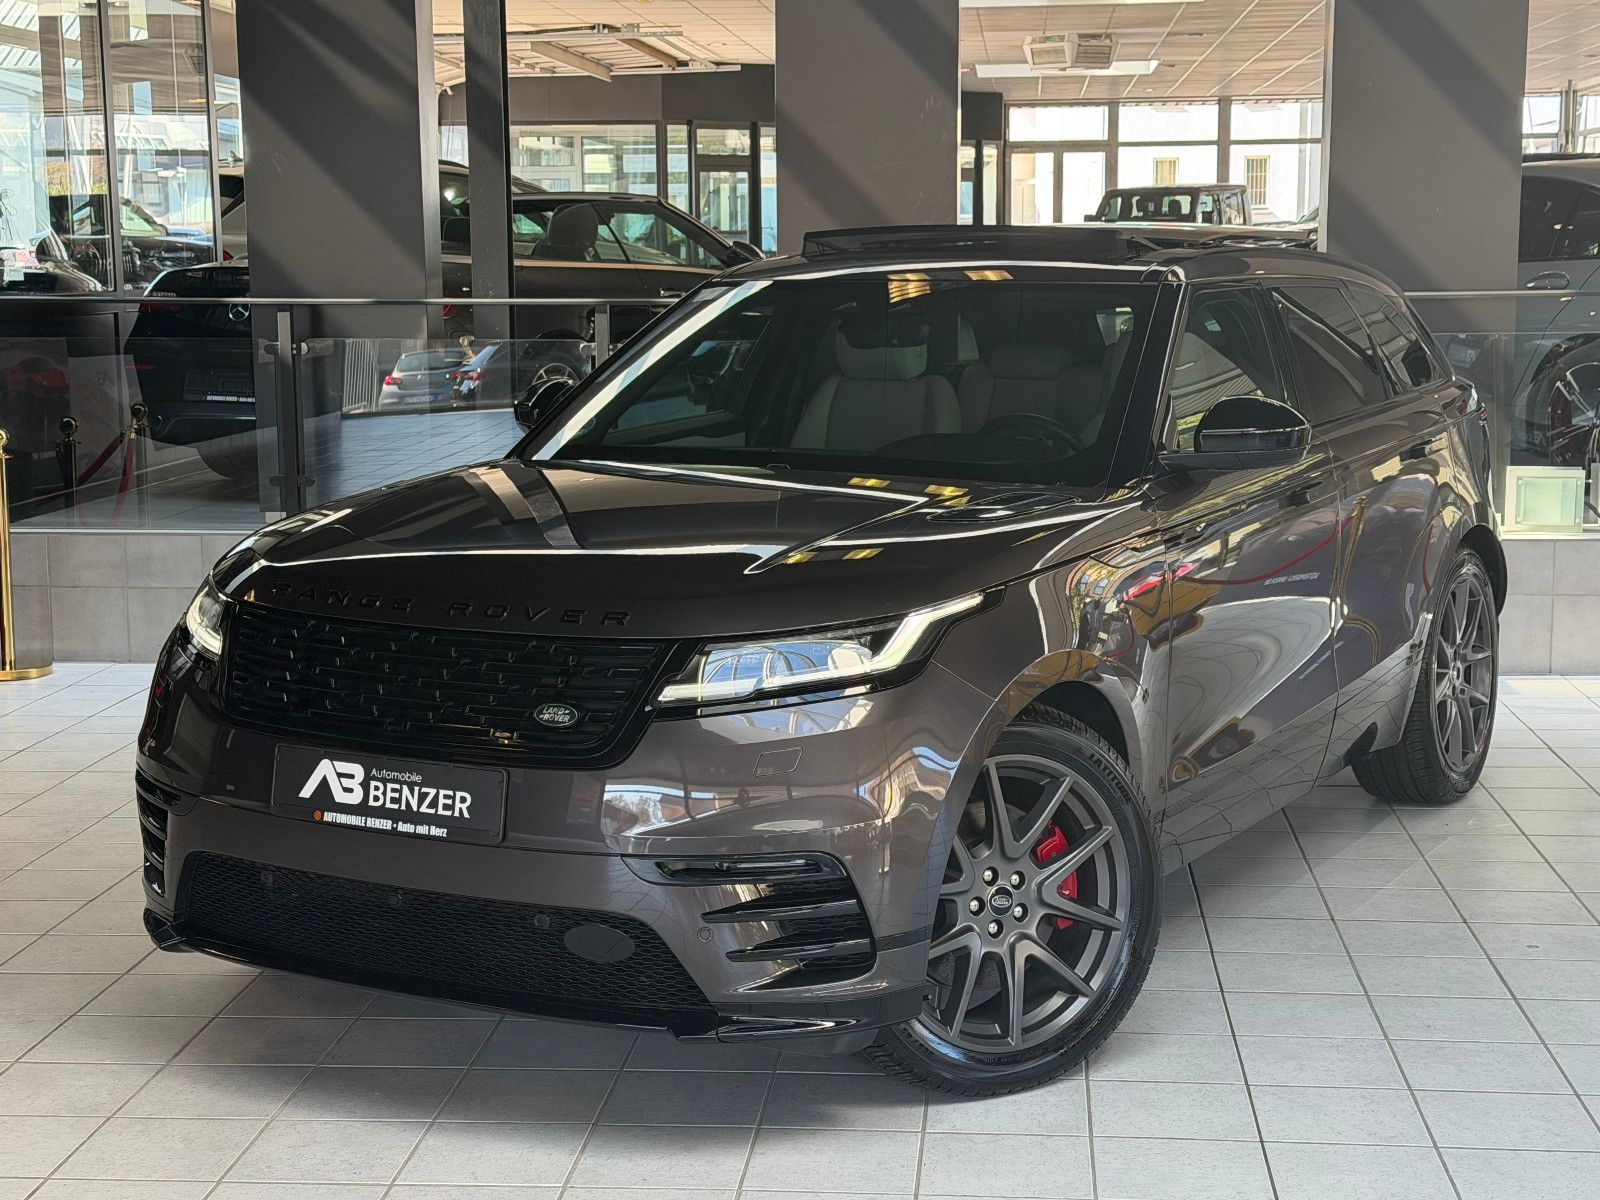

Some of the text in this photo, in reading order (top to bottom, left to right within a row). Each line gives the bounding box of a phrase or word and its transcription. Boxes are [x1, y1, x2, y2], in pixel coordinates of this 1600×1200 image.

[448, 600, 632, 628] ROVER
[542, 706, 565, 715] LAND
[542, 713, 571, 722] ROVER
[370, 767, 423, 783] Automobile
[367, 780, 472, 819] BENZER
[322, 811, 448, 838] AUTOMOBILE BENZER Auto mit Herz
